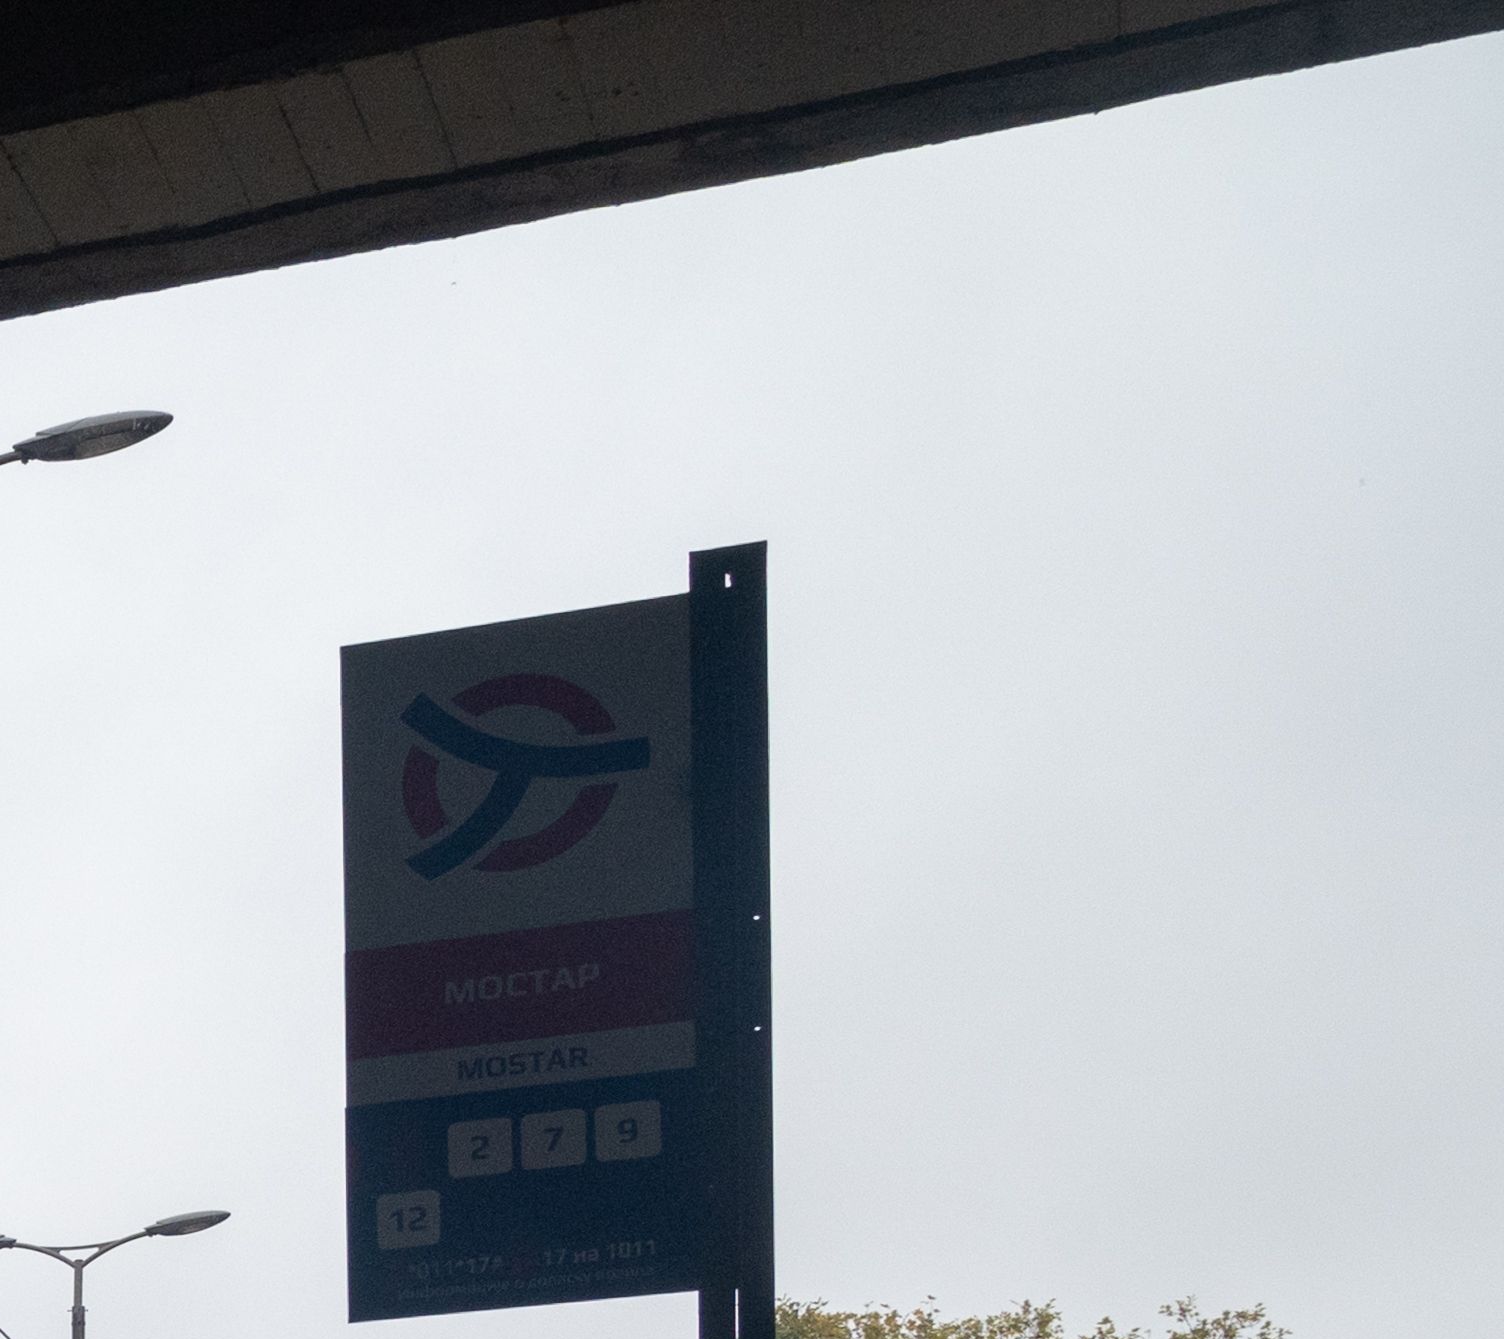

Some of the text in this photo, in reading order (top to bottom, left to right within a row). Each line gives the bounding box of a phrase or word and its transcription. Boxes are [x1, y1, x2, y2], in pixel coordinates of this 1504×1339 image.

[444, 963, 600, 1004] МОСТАР
[457, 1046, 588, 1081] MOSTAR
[469, 1117, 638, 1161] 2 7 9
[389, 1205, 428, 1232] 12
